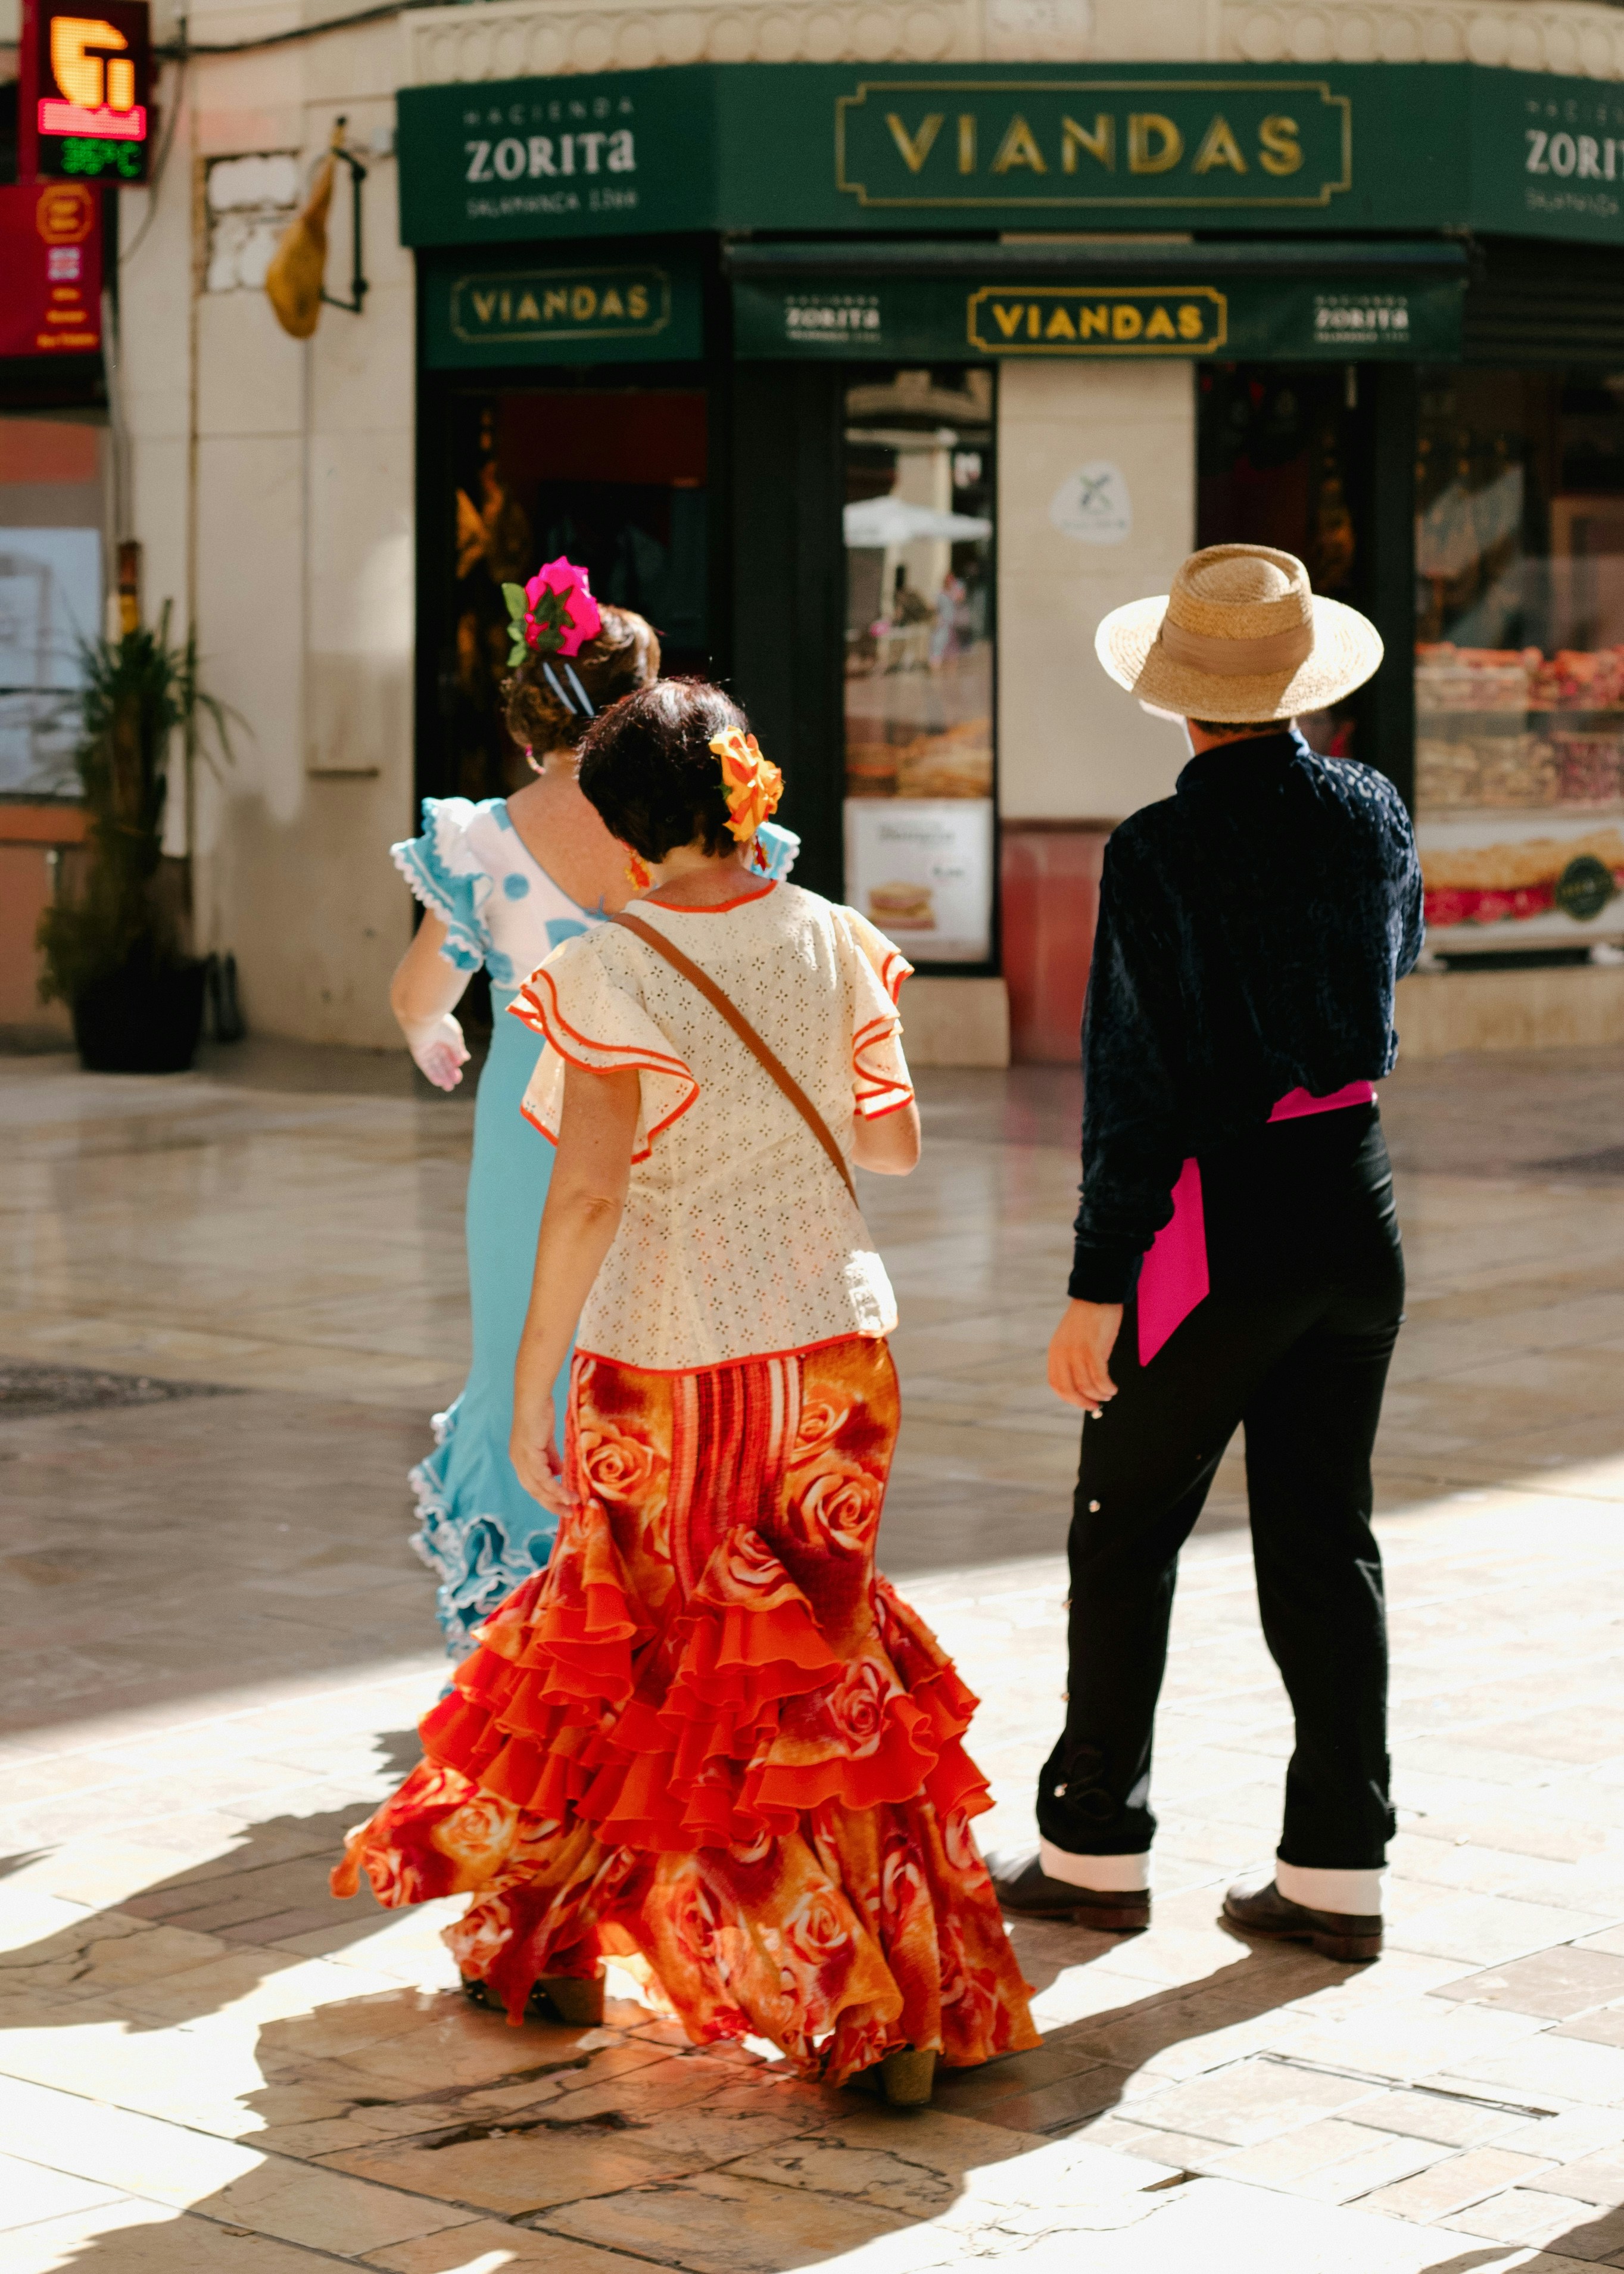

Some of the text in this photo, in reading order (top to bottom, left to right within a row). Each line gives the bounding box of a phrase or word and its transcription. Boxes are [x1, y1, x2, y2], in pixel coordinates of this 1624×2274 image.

[886, 113, 1304, 175] VIANDAS
[471, 284, 650, 323] VIANDAS
[992, 304, 1204, 340] VIANDAS
